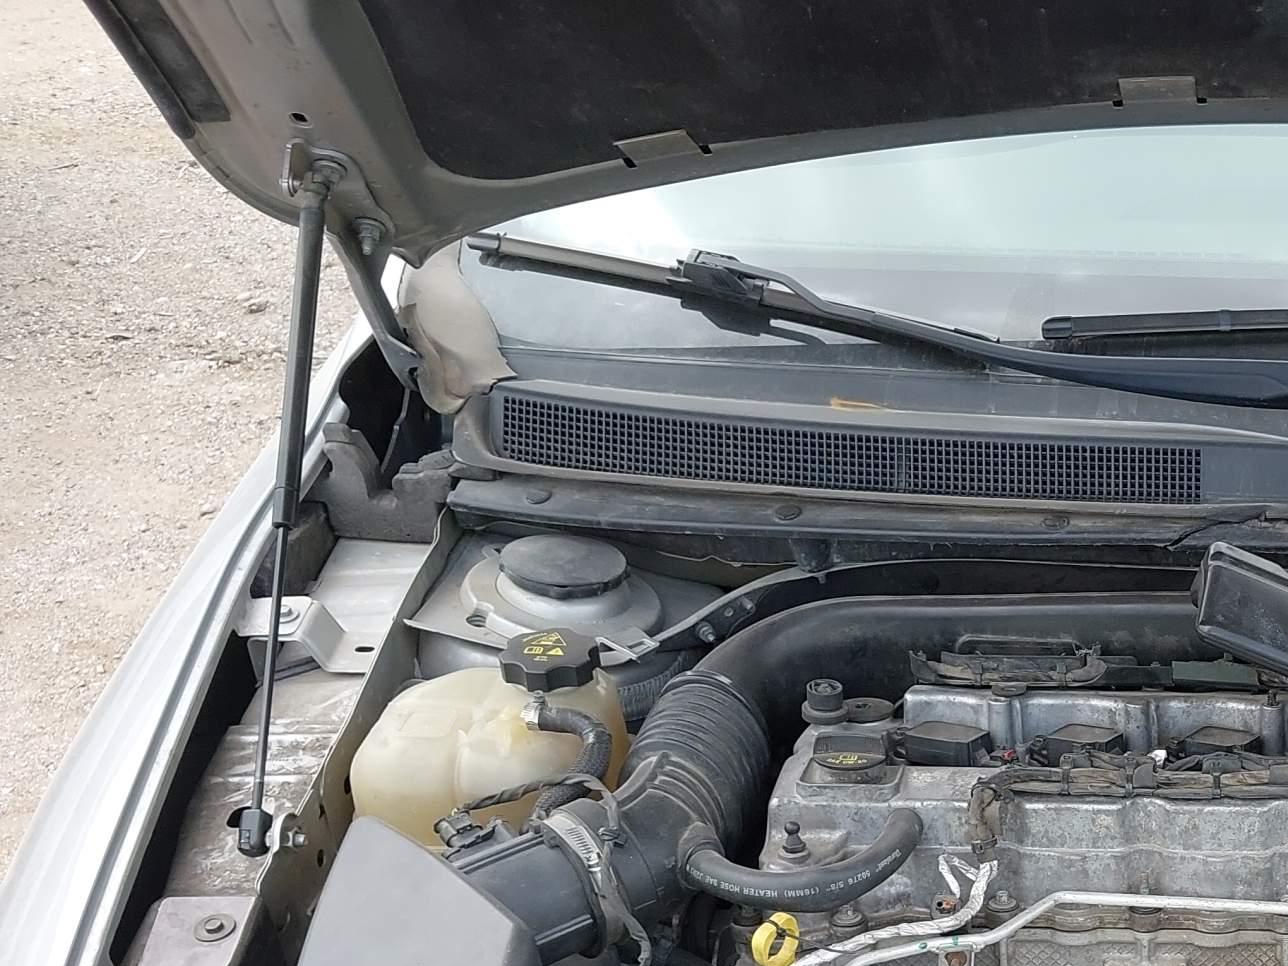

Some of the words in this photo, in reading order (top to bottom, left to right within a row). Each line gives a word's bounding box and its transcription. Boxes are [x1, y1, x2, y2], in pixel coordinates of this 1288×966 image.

[720, 881, 740, 893] HOSE
[743, 887, 778, 898] HEATER
[784, 887, 820, 898] (16MM)
